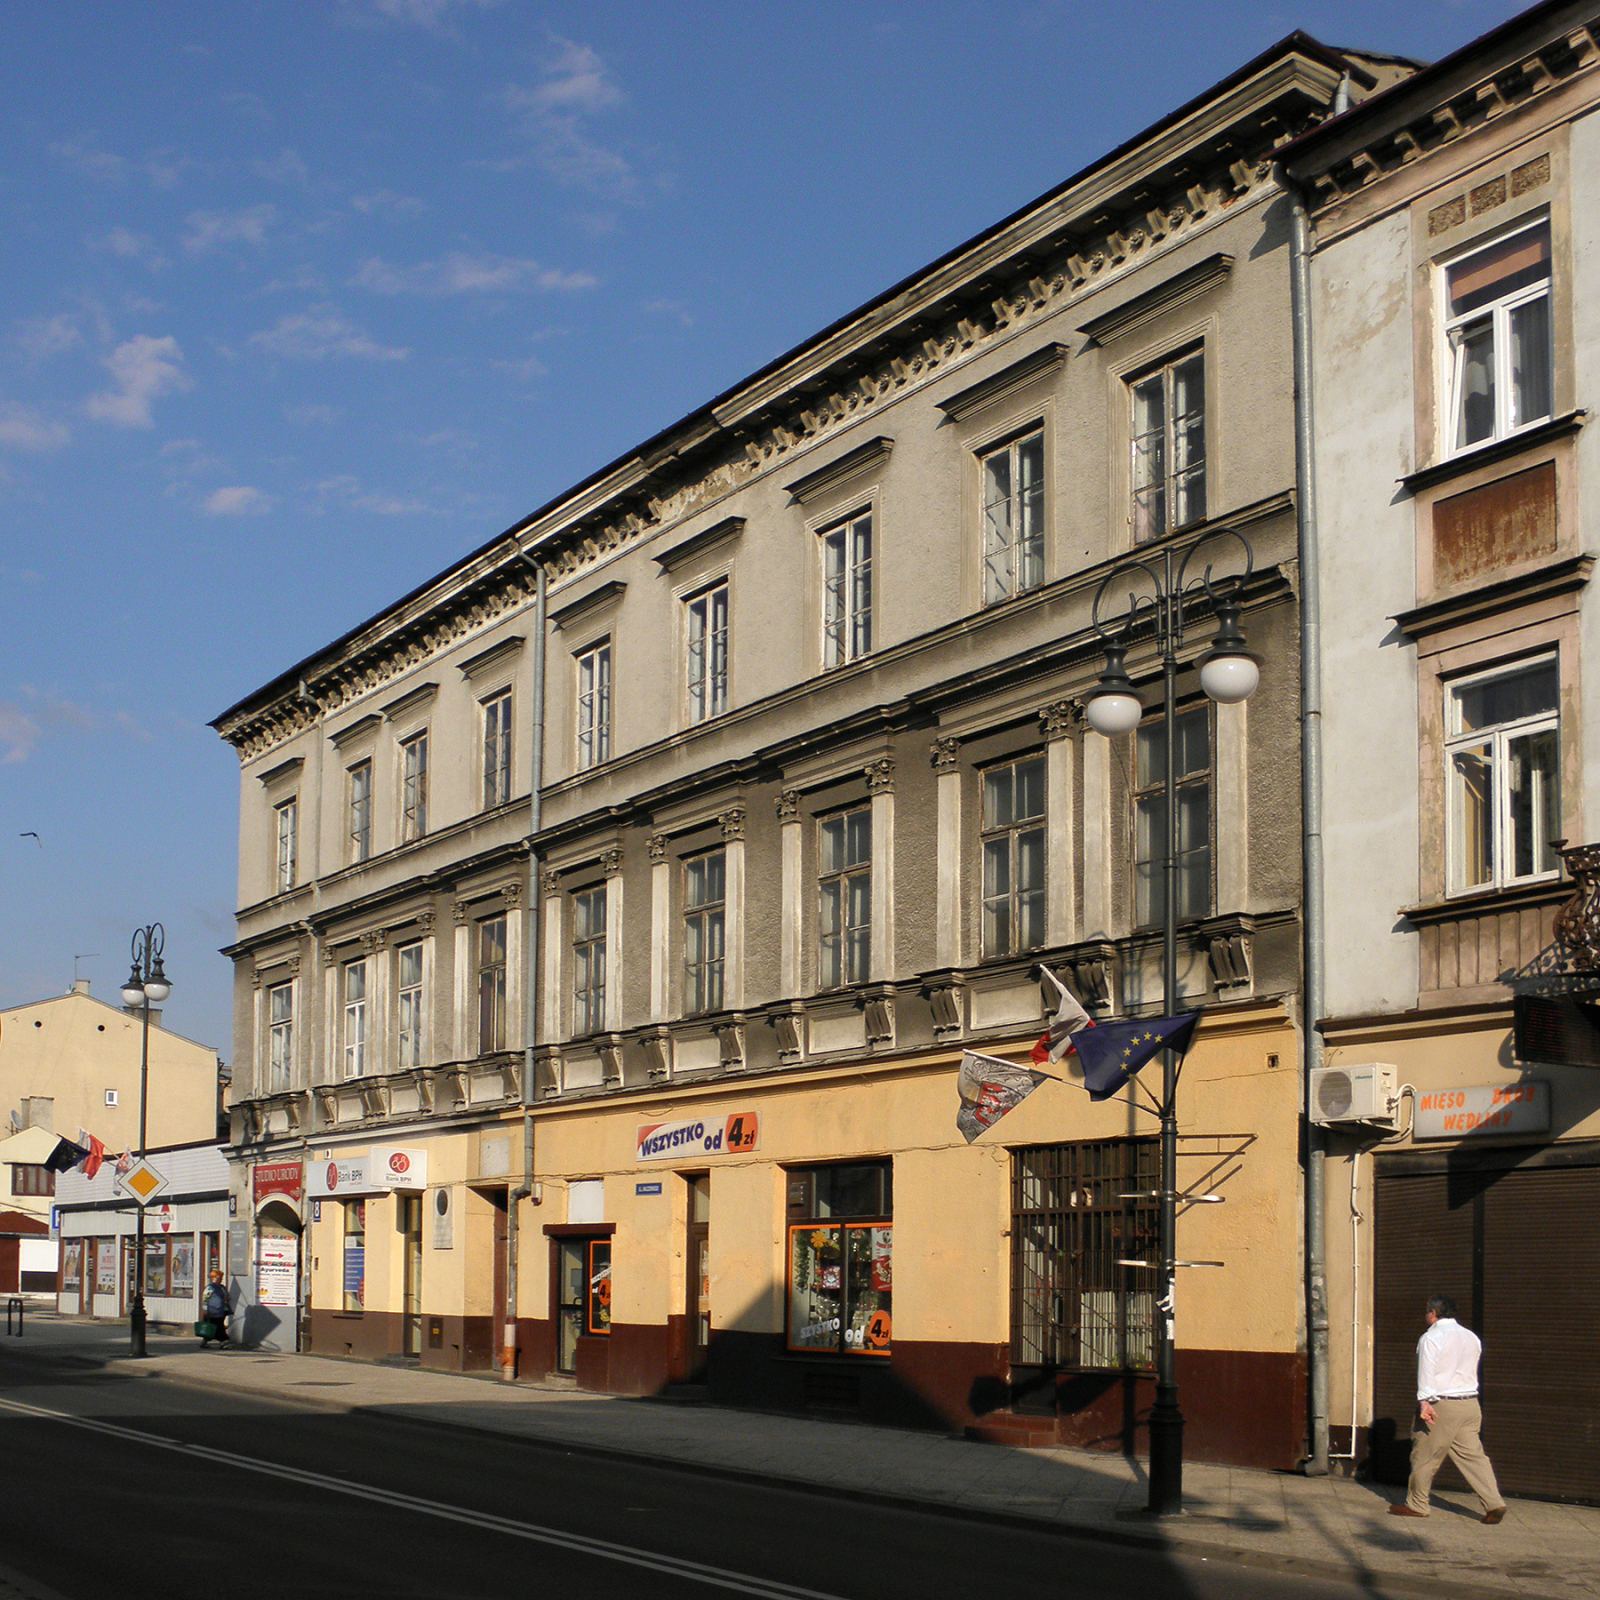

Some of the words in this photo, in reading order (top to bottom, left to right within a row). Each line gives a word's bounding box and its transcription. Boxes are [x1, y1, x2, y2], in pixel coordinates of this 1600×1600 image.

[641, 1122, 704, 1156] WSZYSTKO
[704, 1128, 723, 1150] od
[728, 1117, 744, 1146] 4
[744, 1129, 754, 1145] zł
[338, 1171, 351, 1183] Bank
[230, 1197, 236, 1211] 8
[314, 1200, 320, 1218] 8
[845, 1325, 865, 1343] od
[871, 1319, 882, 1338] 4
